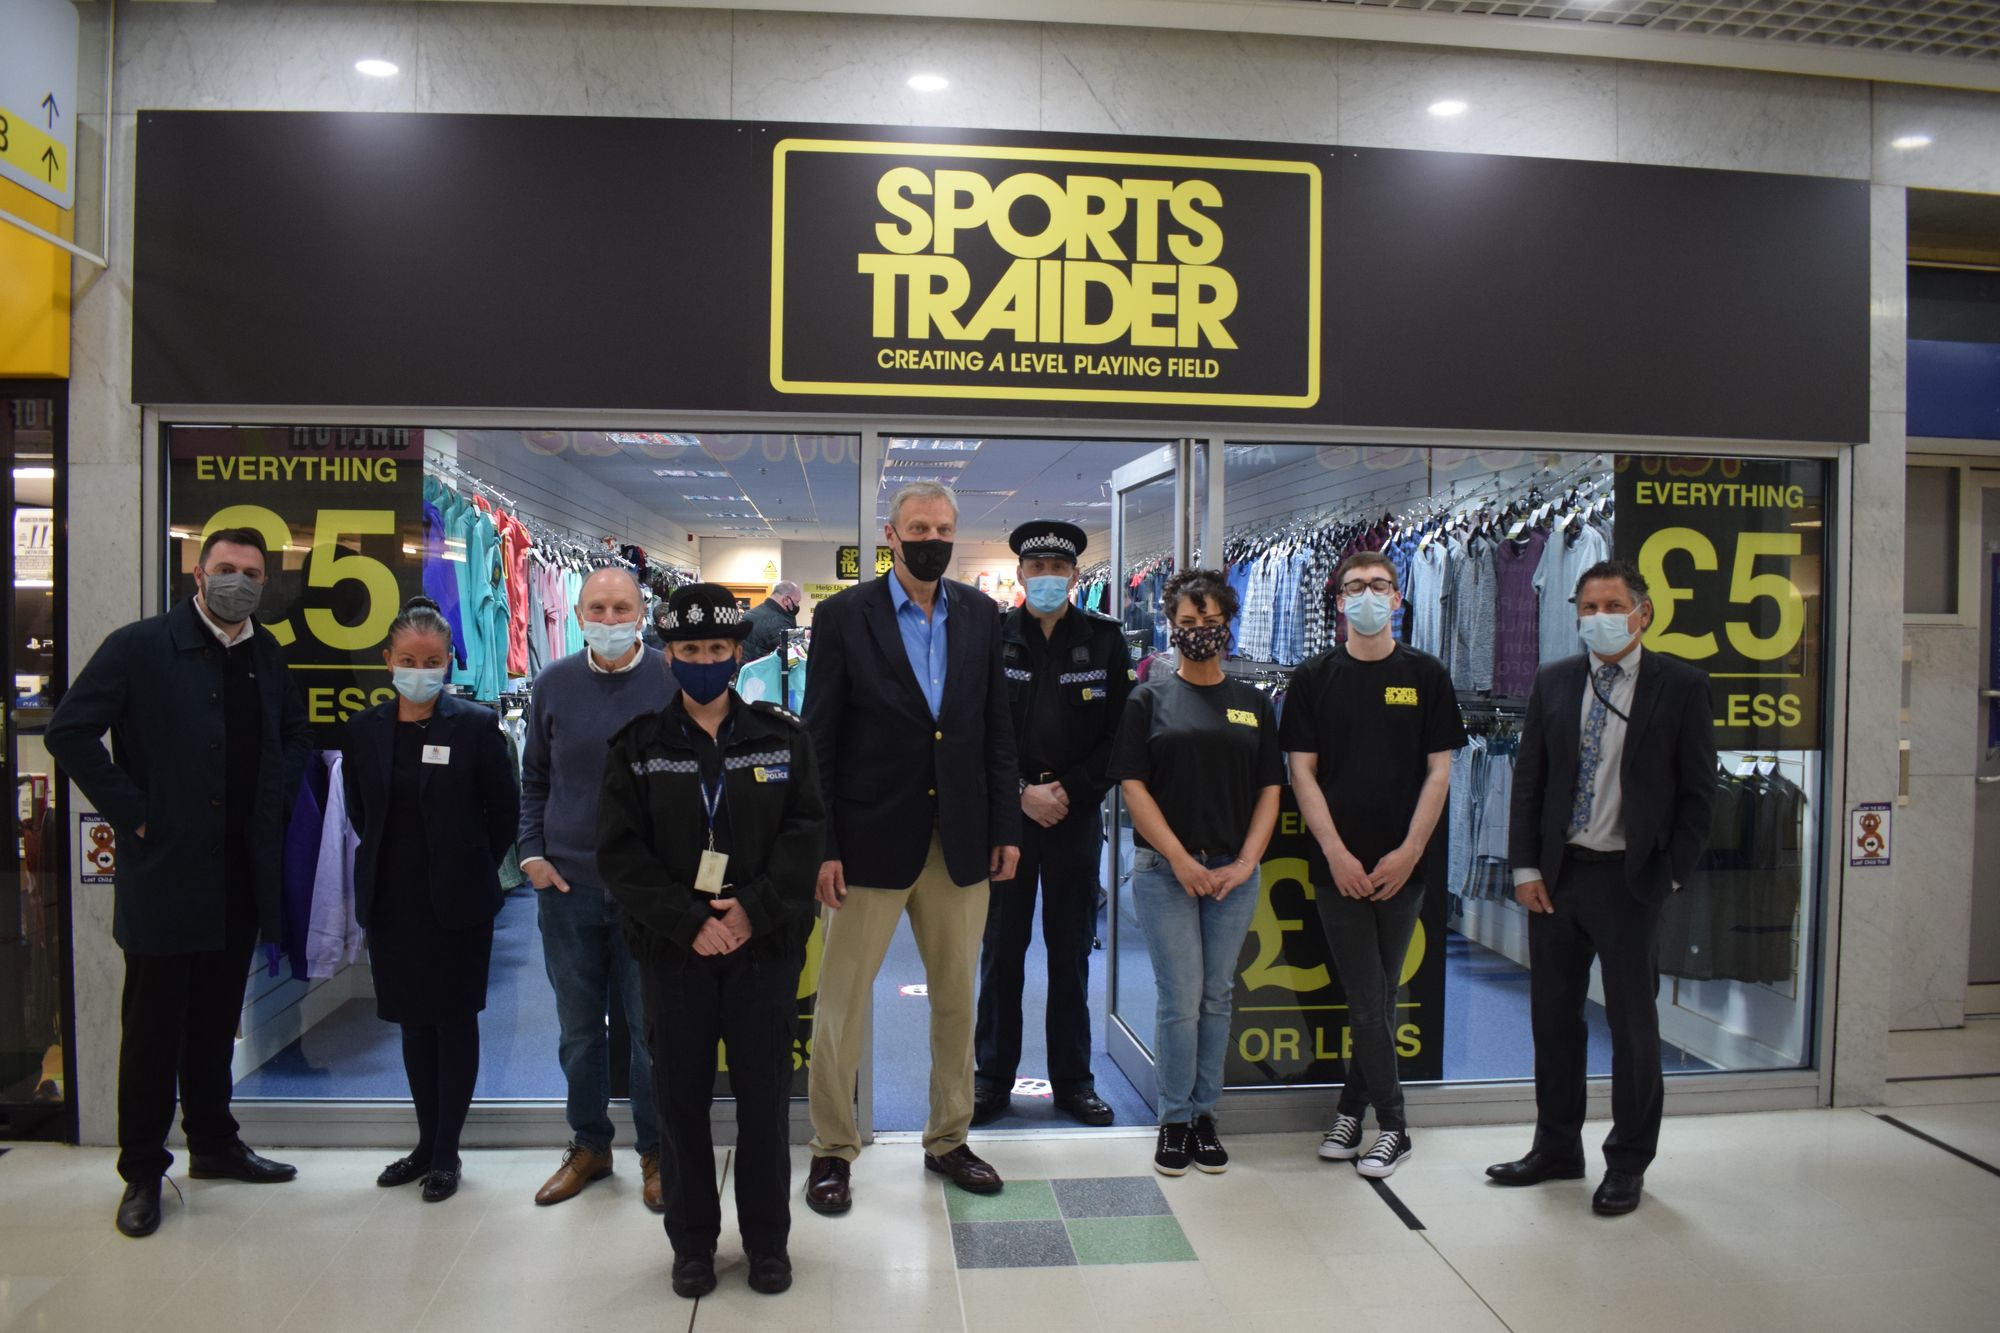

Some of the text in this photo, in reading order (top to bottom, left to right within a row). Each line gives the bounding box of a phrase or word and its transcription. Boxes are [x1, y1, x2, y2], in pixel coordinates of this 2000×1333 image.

[875, 166, 1224, 265] SPORTS
[857, 253, 1239, 349] TRAIDER
[877, 348, 1220, 378] CREATING A LEVEL PLAYING FIELD
[196, 456, 398, 482] EVERYTHING
[1636, 481, 1804, 509] EVERYTHING
[1637, 526, 1805, 661] £5
[1713, 693, 1802, 727] ESS
[767, 772, 788, 780] POLICE
[1238, 1027, 1301, 1063] OR
